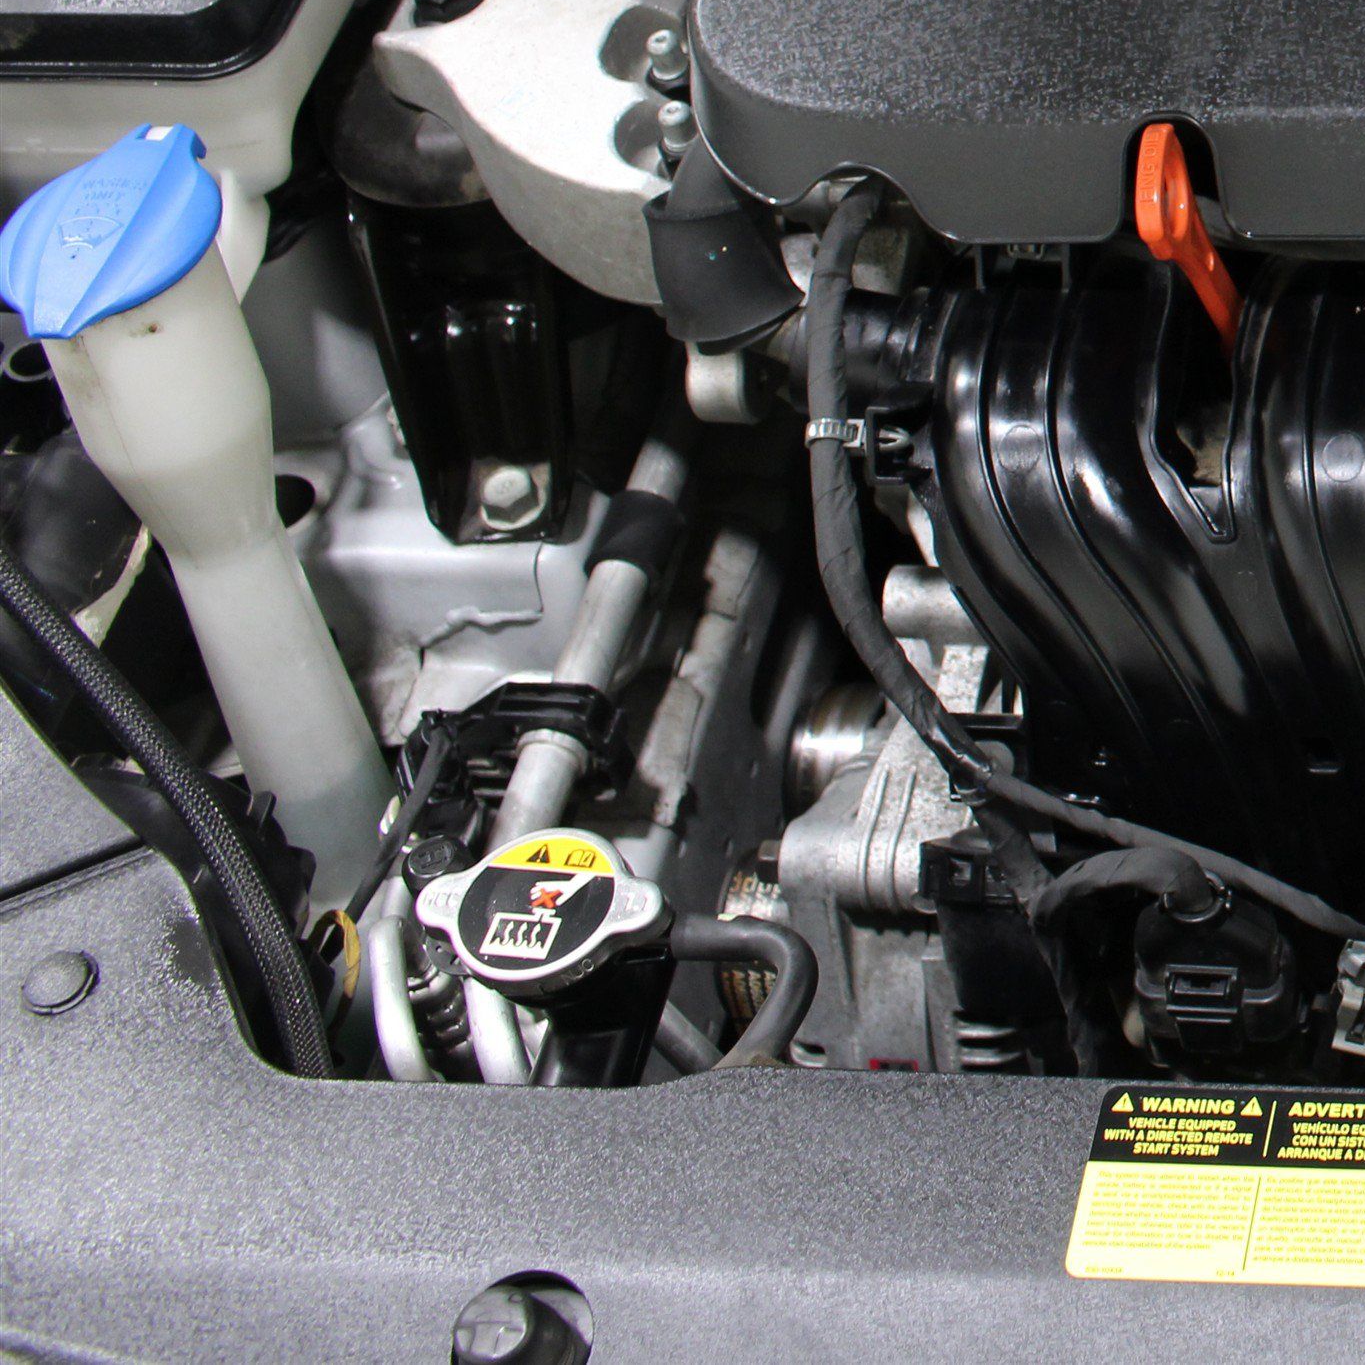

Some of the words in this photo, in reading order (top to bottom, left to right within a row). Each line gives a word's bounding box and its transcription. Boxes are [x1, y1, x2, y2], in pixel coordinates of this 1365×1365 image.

[1140, 164, 1156, 203] ENG
[1142, 1096, 1235, 1115] WARNING
[1128, 1117, 1177, 1130] VEHICLE
[1177, 1119, 1236, 1132] EQUIPPED
[1293, 1121, 1350, 1135] VEHÍCULO
[1104, 1128, 1135, 1141] WITH
[1136, 1130, 1145, 1142] A
[1146, 1130, 1203, 1144] DIRECTED
[1204, 1132, 1254, 1145] REMOTE
[1292, 1134, 1317, 1147] CON
[1318, 1135, 1336, 1148] UN
[1133, 1143, 1171, 1155] START
[1171, 1144, 1220, 1157] SYSTEM
[1277, 1147, 1343, 1161] ARRANQUE
[1344, 1149, 1353, 1161] A
